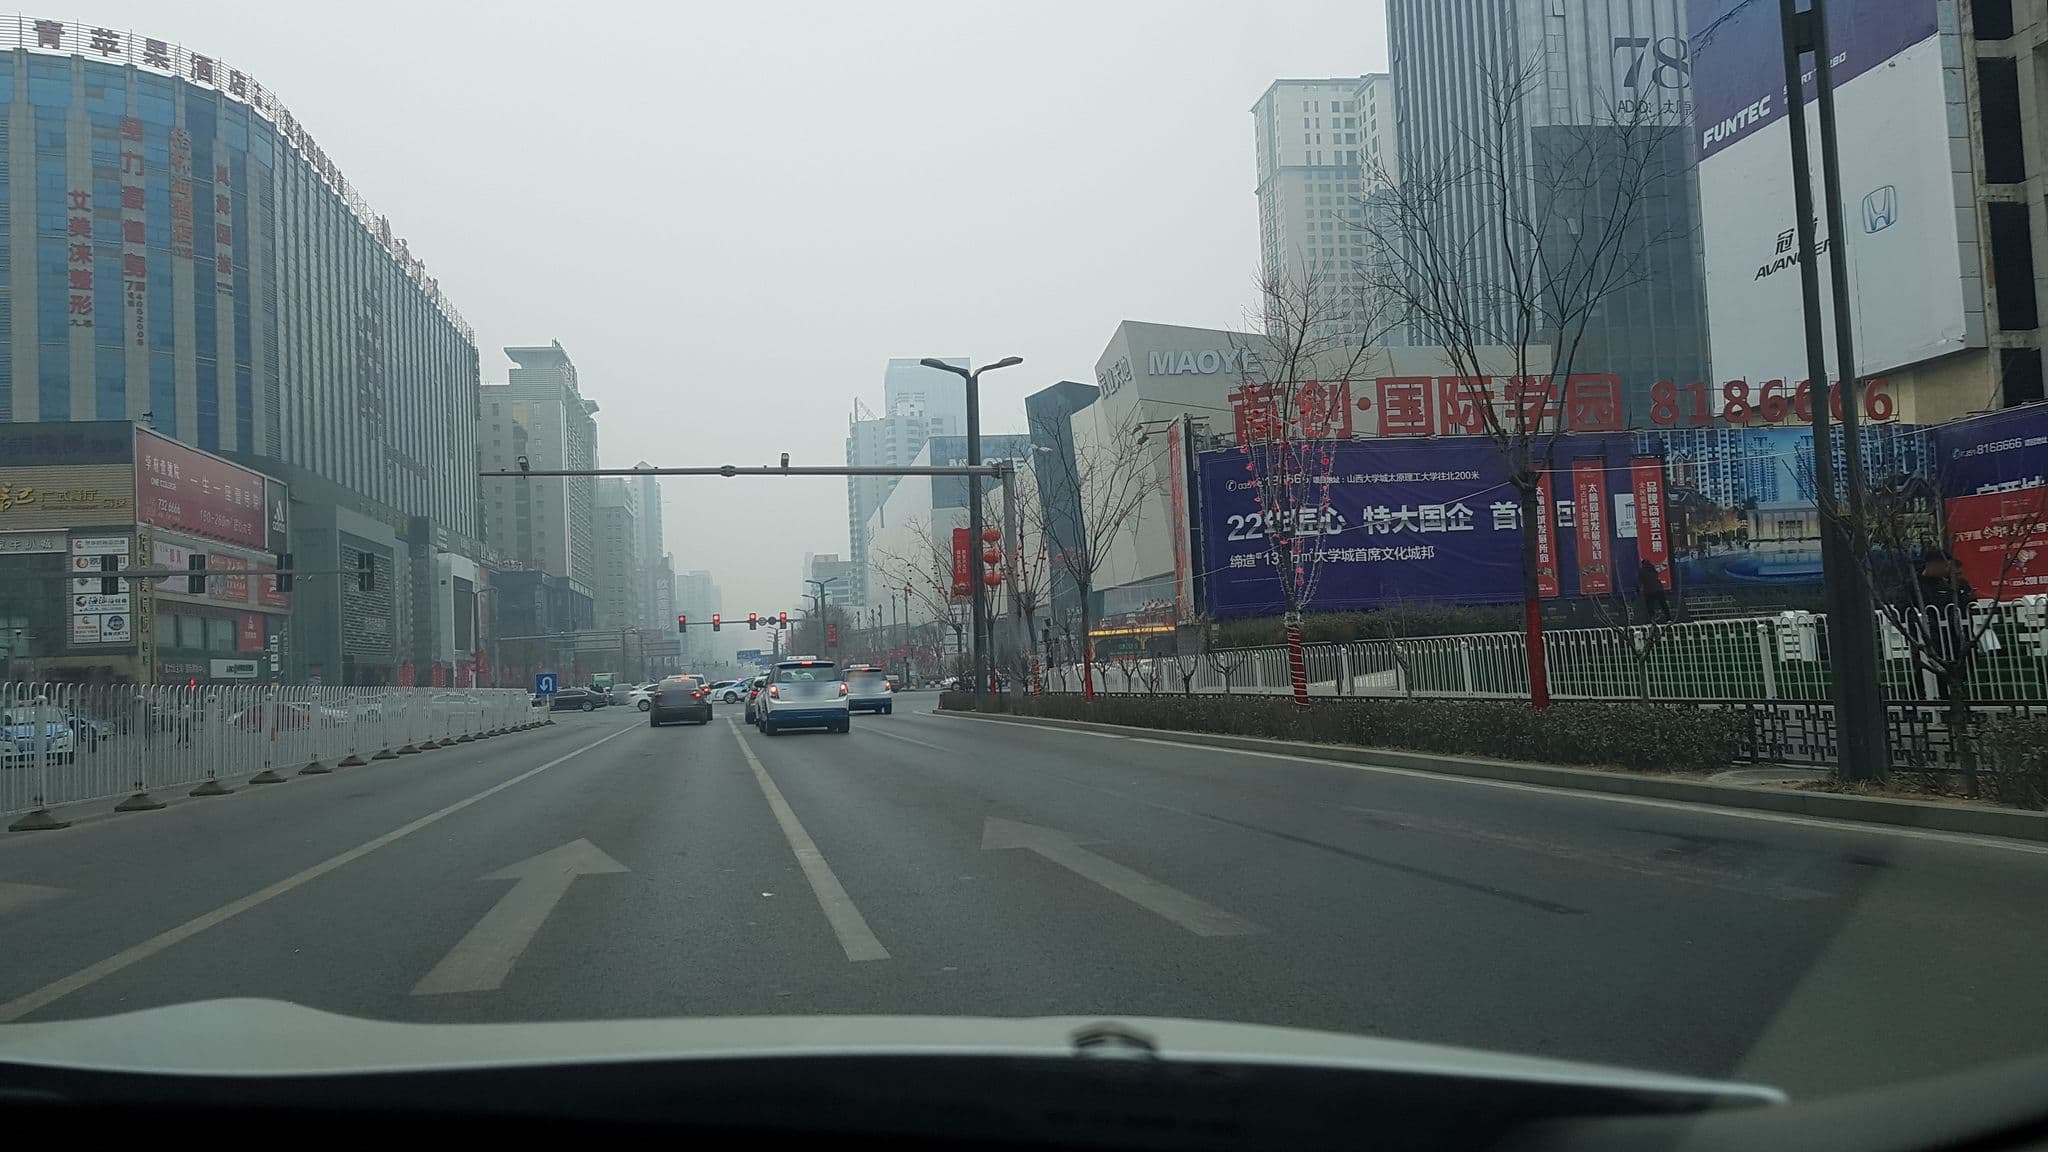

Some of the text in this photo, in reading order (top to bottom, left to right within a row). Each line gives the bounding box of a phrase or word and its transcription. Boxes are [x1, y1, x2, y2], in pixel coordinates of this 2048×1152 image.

[33, 19, 247, 99] 青苹果酒店
[1614, 36, 1690, 89] 78
[1702, 94, 1771, 149] FUNTEC
[1148, 350, 1260, 376] MAOYE
[1363, 502, 1474, 535] 特大国企
[1647, 481, 1662, 553] 品牌商家云集
